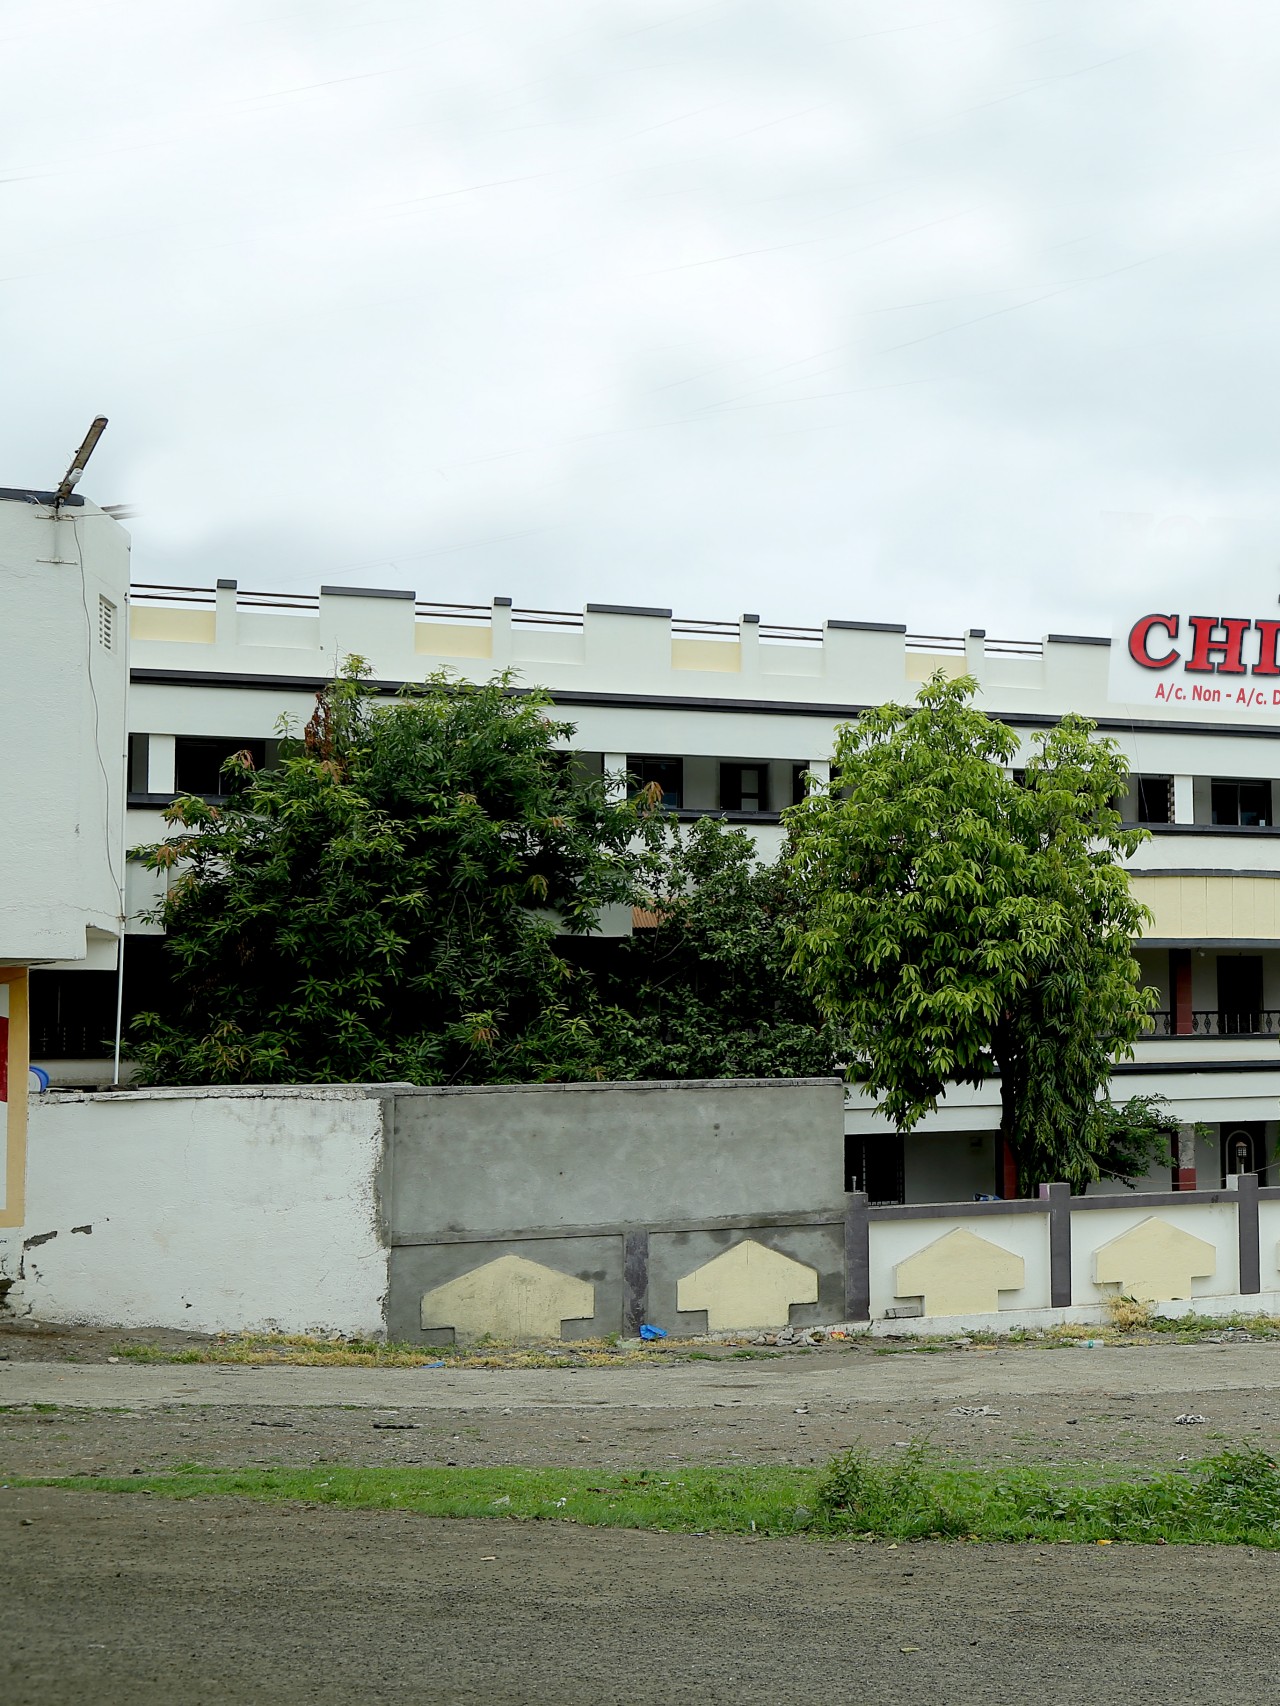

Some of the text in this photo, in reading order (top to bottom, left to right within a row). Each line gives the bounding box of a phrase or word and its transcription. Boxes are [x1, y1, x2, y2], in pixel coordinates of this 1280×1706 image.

[1155, 683, 1187, 702] A/c.
[1191, 685, 1221, 702] Non
[1235, 687, 1267, 707] A/c.
